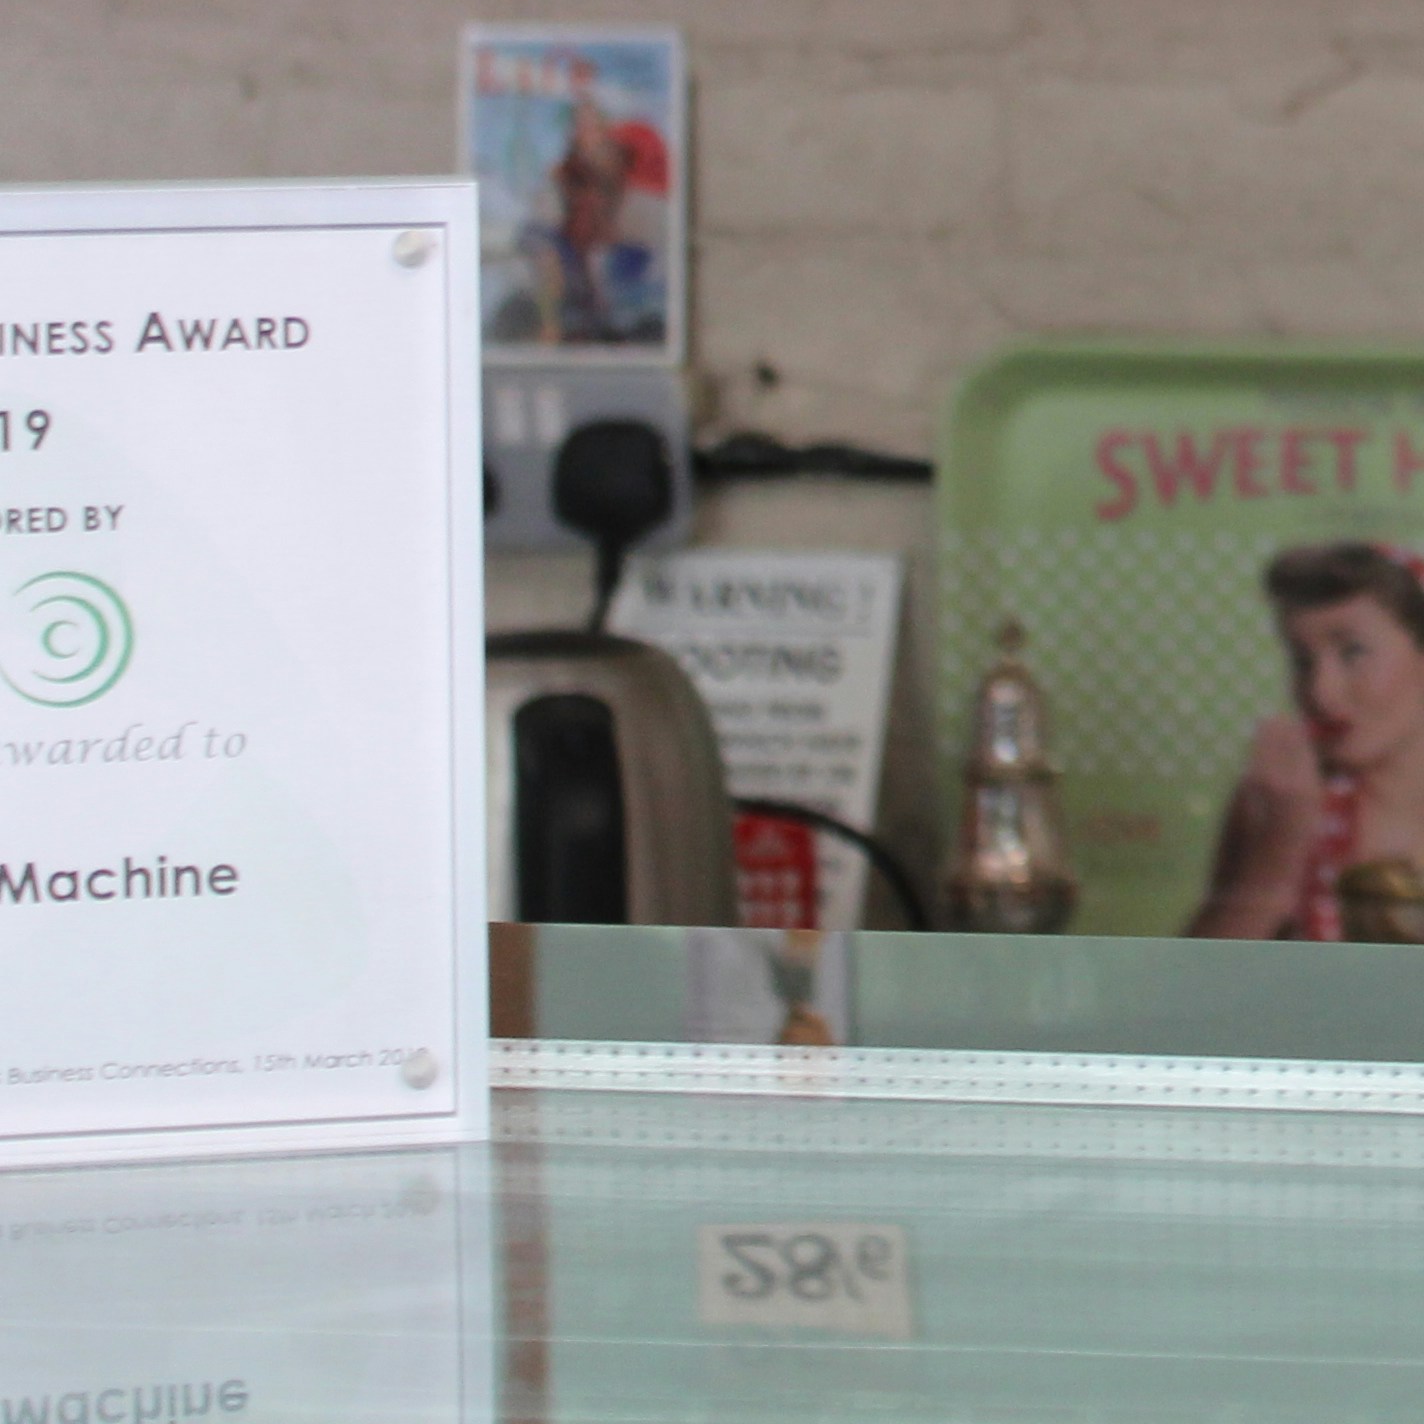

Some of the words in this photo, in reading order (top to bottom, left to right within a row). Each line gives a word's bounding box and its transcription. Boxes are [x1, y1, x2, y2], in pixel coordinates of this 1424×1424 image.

[1092, 424, 1370, 524] SWEET
[0, 506, 68, 535] RED
[83, 504, 125, 532] BY
[203, 728, 248, 760] to
[0, 855, 240, 905] Machine
[7, 1064, 95, 1086] Business
[301, 1050, 374, 1069] March
